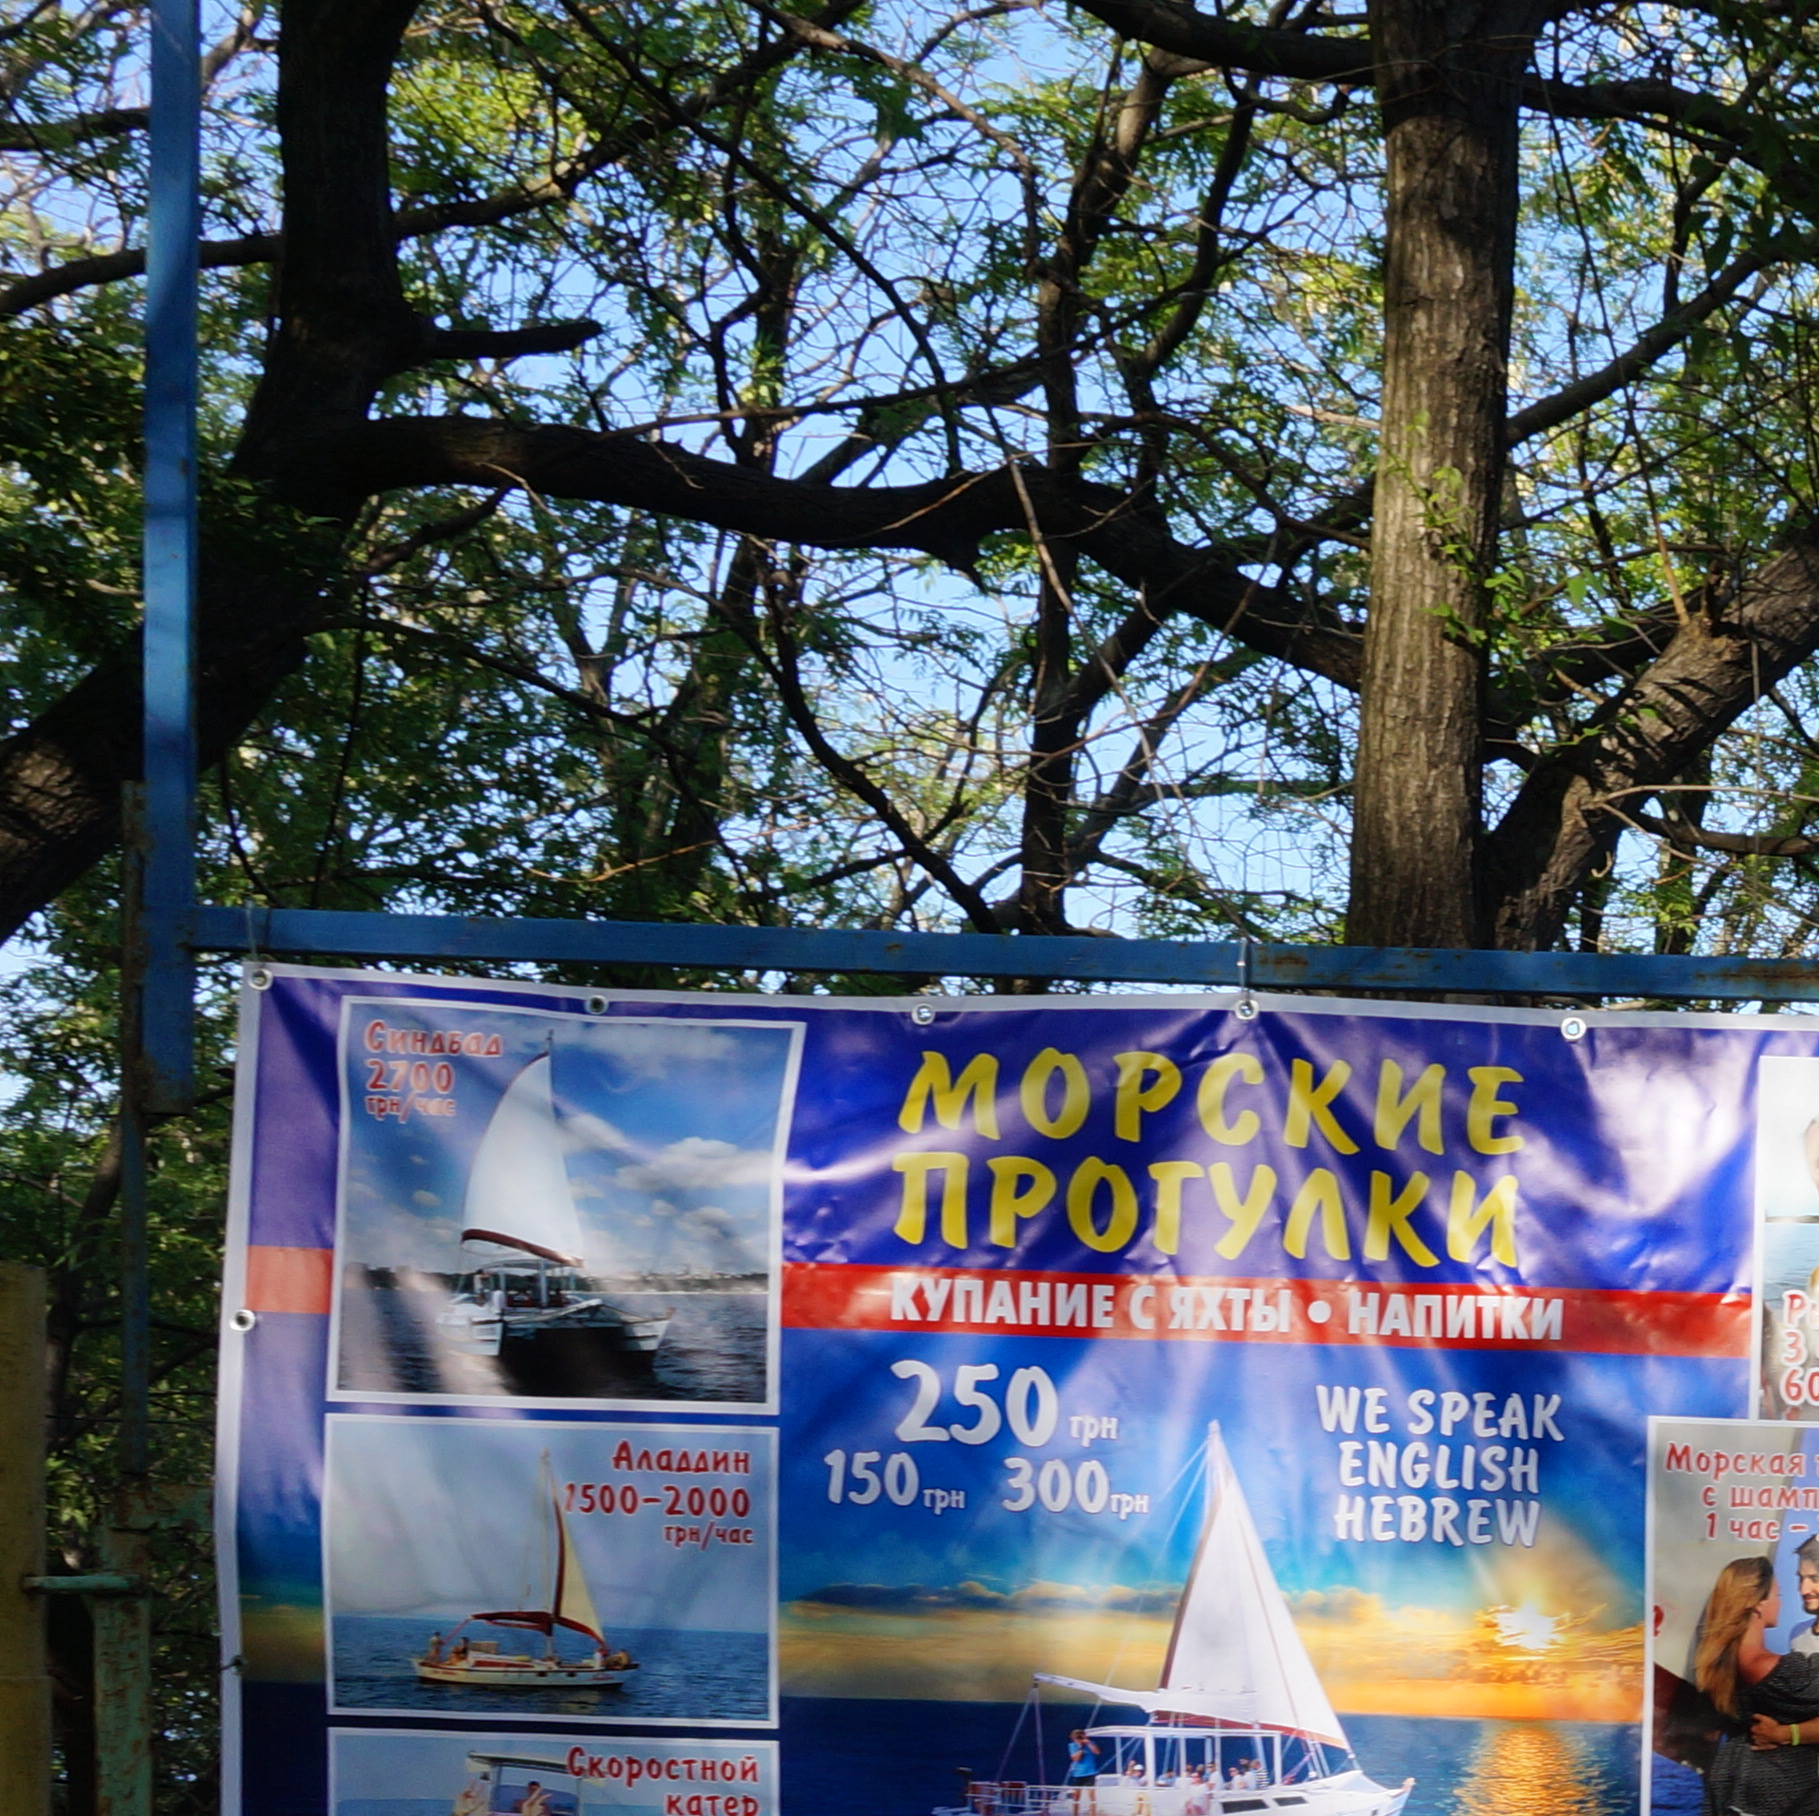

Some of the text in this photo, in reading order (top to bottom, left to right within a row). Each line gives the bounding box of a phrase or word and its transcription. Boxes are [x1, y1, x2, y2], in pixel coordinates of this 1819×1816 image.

[364, 1019, 502, 1057] Синдбад
[365, 1058, 455, 1093] 2700
[365, 1092, 456, 1121] грн/час
[898, 1047, 1525, 1156] МОРСКИЕ
[890, 1151, 1519, 1269] ПРОГУЛКИ
[890, 1277, 1564, 1341] КУПАНИЕ С ЯХТЫ НАПИТКИ
[1784, 1331, 1806, 1364] 3
[890, 1359, 1118, 1447] 250 грн
[1316, 1384, 1564, 1442] WE SPEAK
[611, 1440, 750, 1474] Аладдин
[1339, 1439, 1539, 1495] ENGLISH
[1666, 1443, 1804, 1481] Морская
[823, 1449, 1149, 1519] 150 грн 300 грн
[1702, 1487, 1717, 1506] с
[664, 1521, 753, 1550] грн/час
[1334, 1495, 1541, 1549] HEBREW
[1706, 1513, 1718, 1540] 1
[1729, 1517, 1781, 1542] час
[566, 1745, 759, 1787] Скоростной
